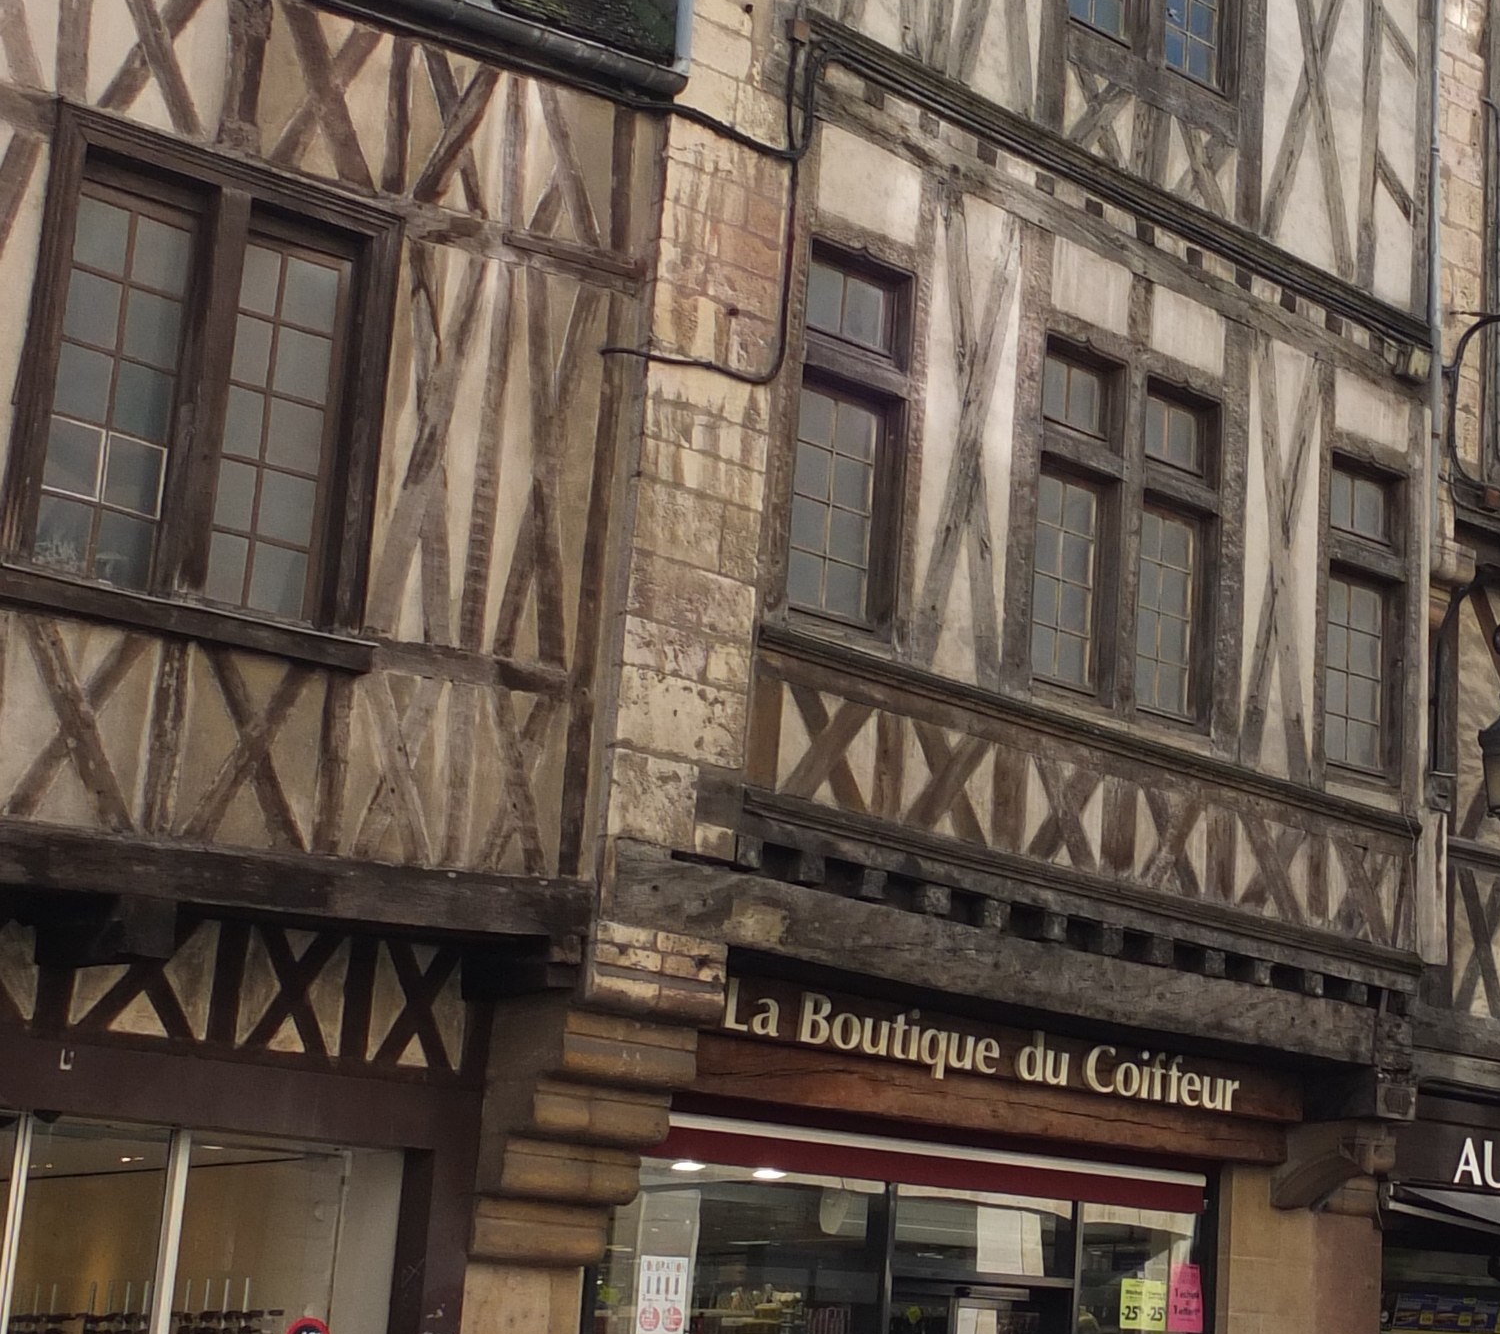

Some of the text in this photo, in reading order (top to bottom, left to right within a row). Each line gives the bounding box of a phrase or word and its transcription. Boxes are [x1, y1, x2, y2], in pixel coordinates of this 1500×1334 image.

[723, 977, 1240, 1112] La Boutique du Coiffeur
